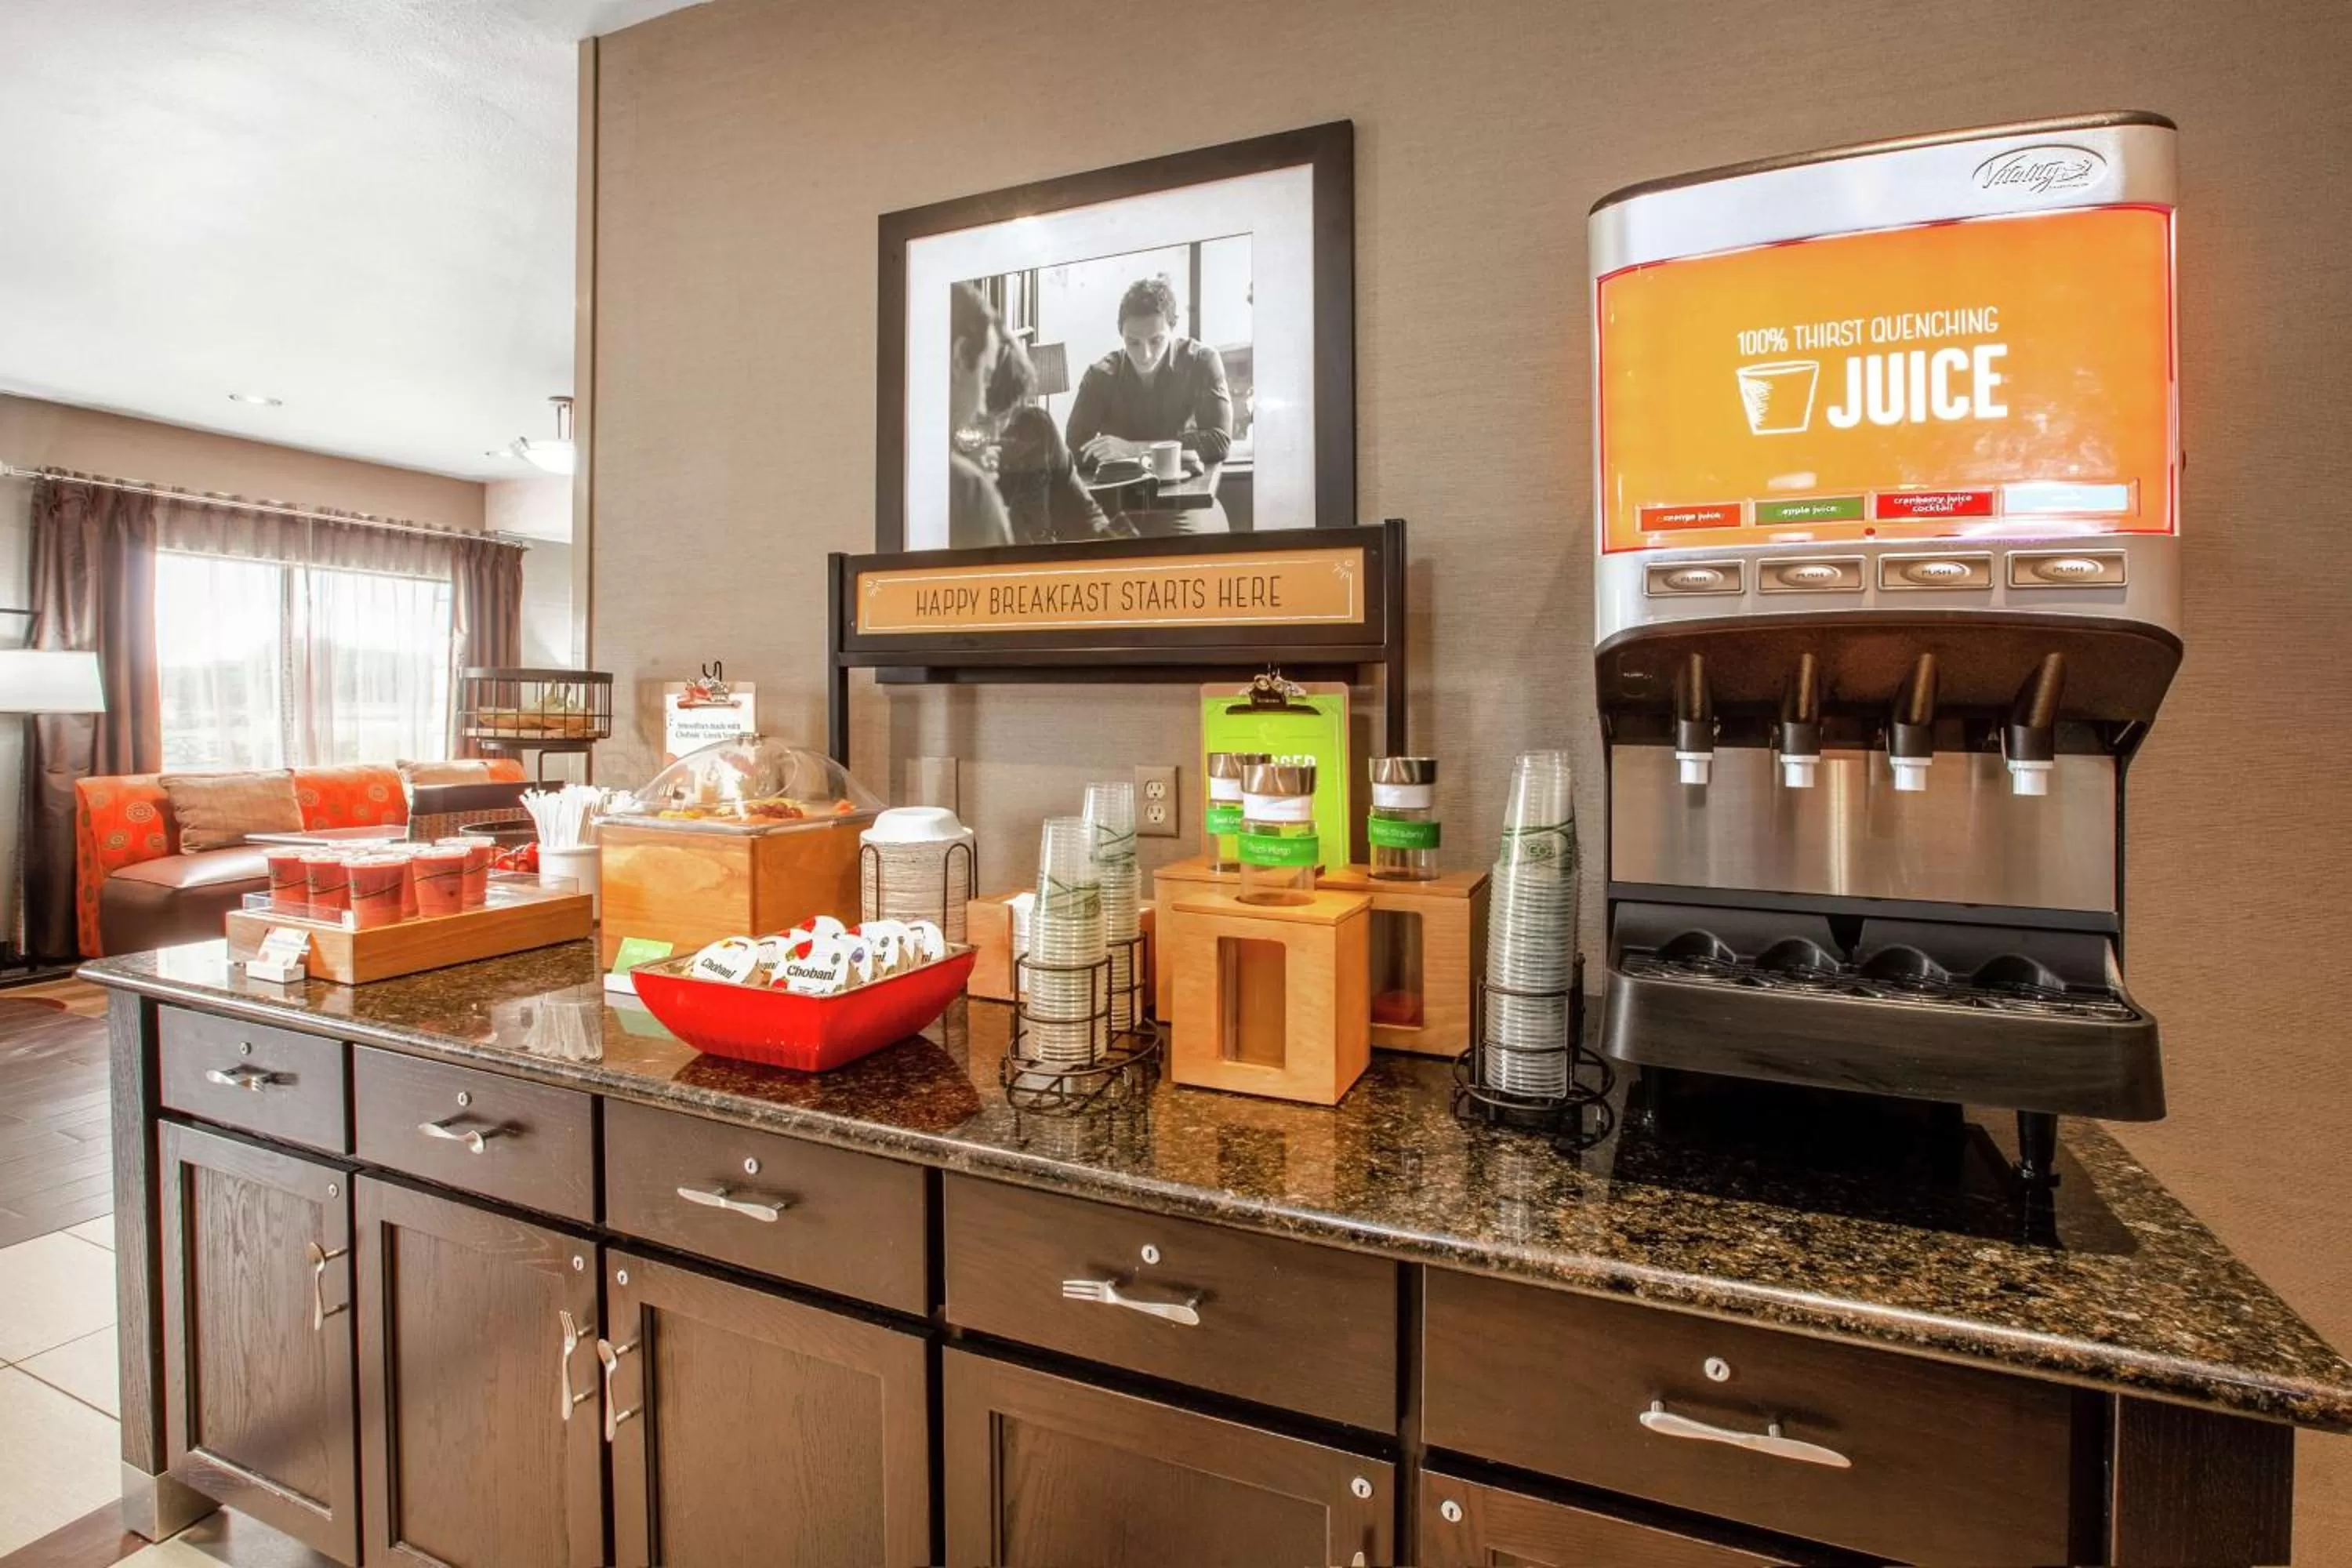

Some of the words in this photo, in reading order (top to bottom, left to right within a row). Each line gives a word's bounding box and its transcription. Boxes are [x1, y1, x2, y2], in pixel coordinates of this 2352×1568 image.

[1737, 328, 1789, 356] 100%
[1794, 318, 1865, 350] THIRST
[1871, 306, 1999, 343] QUENCHING
[1827, 344, 2009, 428] JUICE
[1911, 503, 1954, 513] cocktail
[1947, 494, 1973, 506] juice
[1780, 506, 1810, 517] apple
[1813, 504, 1837, 514] juice
[916, 588, 979, 617] HAPPY
[989, 582, 1113, 615] BREAKFAST
[1121, 578, 1205, 611] STARTS
[1218, 575, 1282, 608] HERE
[700, 957, 737, 978] Chobani
[786, 965, 837, 981] Chobani
